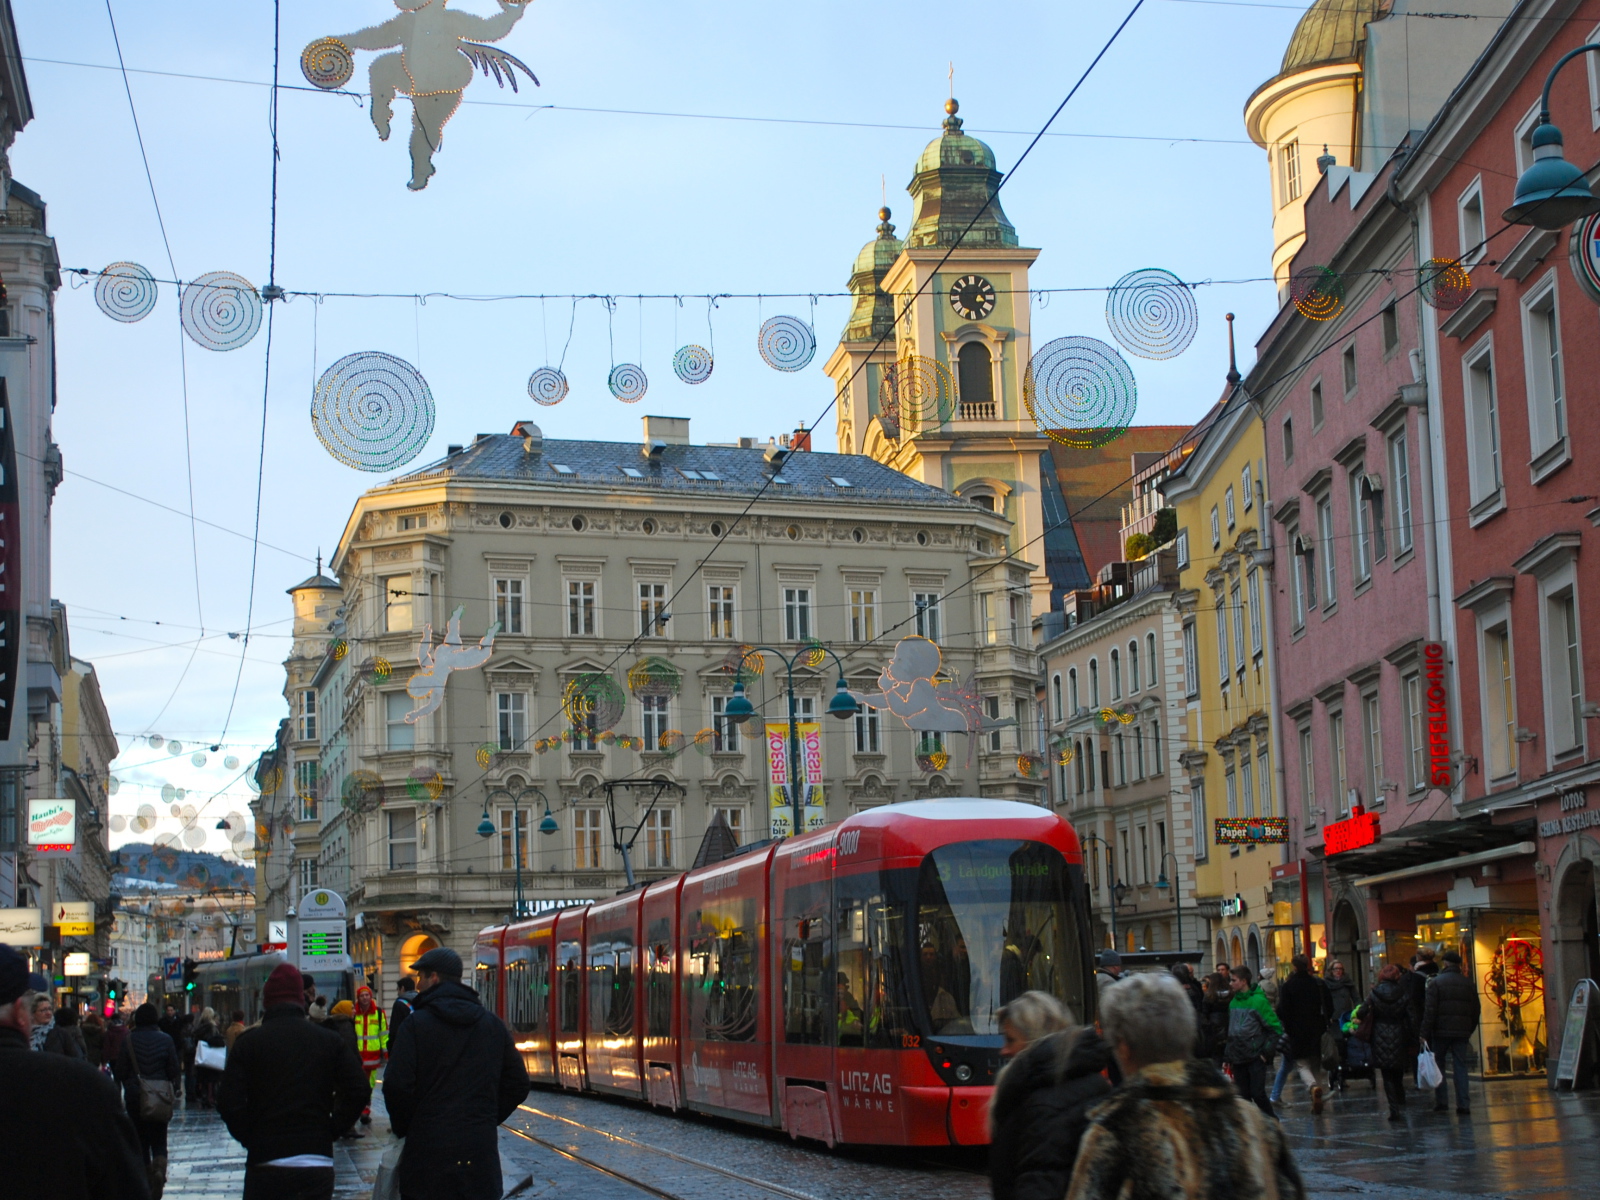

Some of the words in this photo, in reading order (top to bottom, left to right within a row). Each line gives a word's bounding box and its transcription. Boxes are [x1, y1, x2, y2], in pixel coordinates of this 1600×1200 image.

[769, 731, 786, 784] EISBOX
[1561, 791, 1585, 811] LOTOS
[32, 805, 63, 821] Haubi's
[772, 819, 790, 827] 7.12.
[772, 827, 786, 835] bis
[1540, 820, 1561, 837] CHINA
[1220, 827, 1247, 839] Paper
[1264, 826, 1283, 836] Box
[515, 899, 595, 917] HUMA
[902, 1035, 920, 1048] 032
[841, 1070, 871, 1093] LINZ
[872, 1073, 892, 1095] AG
